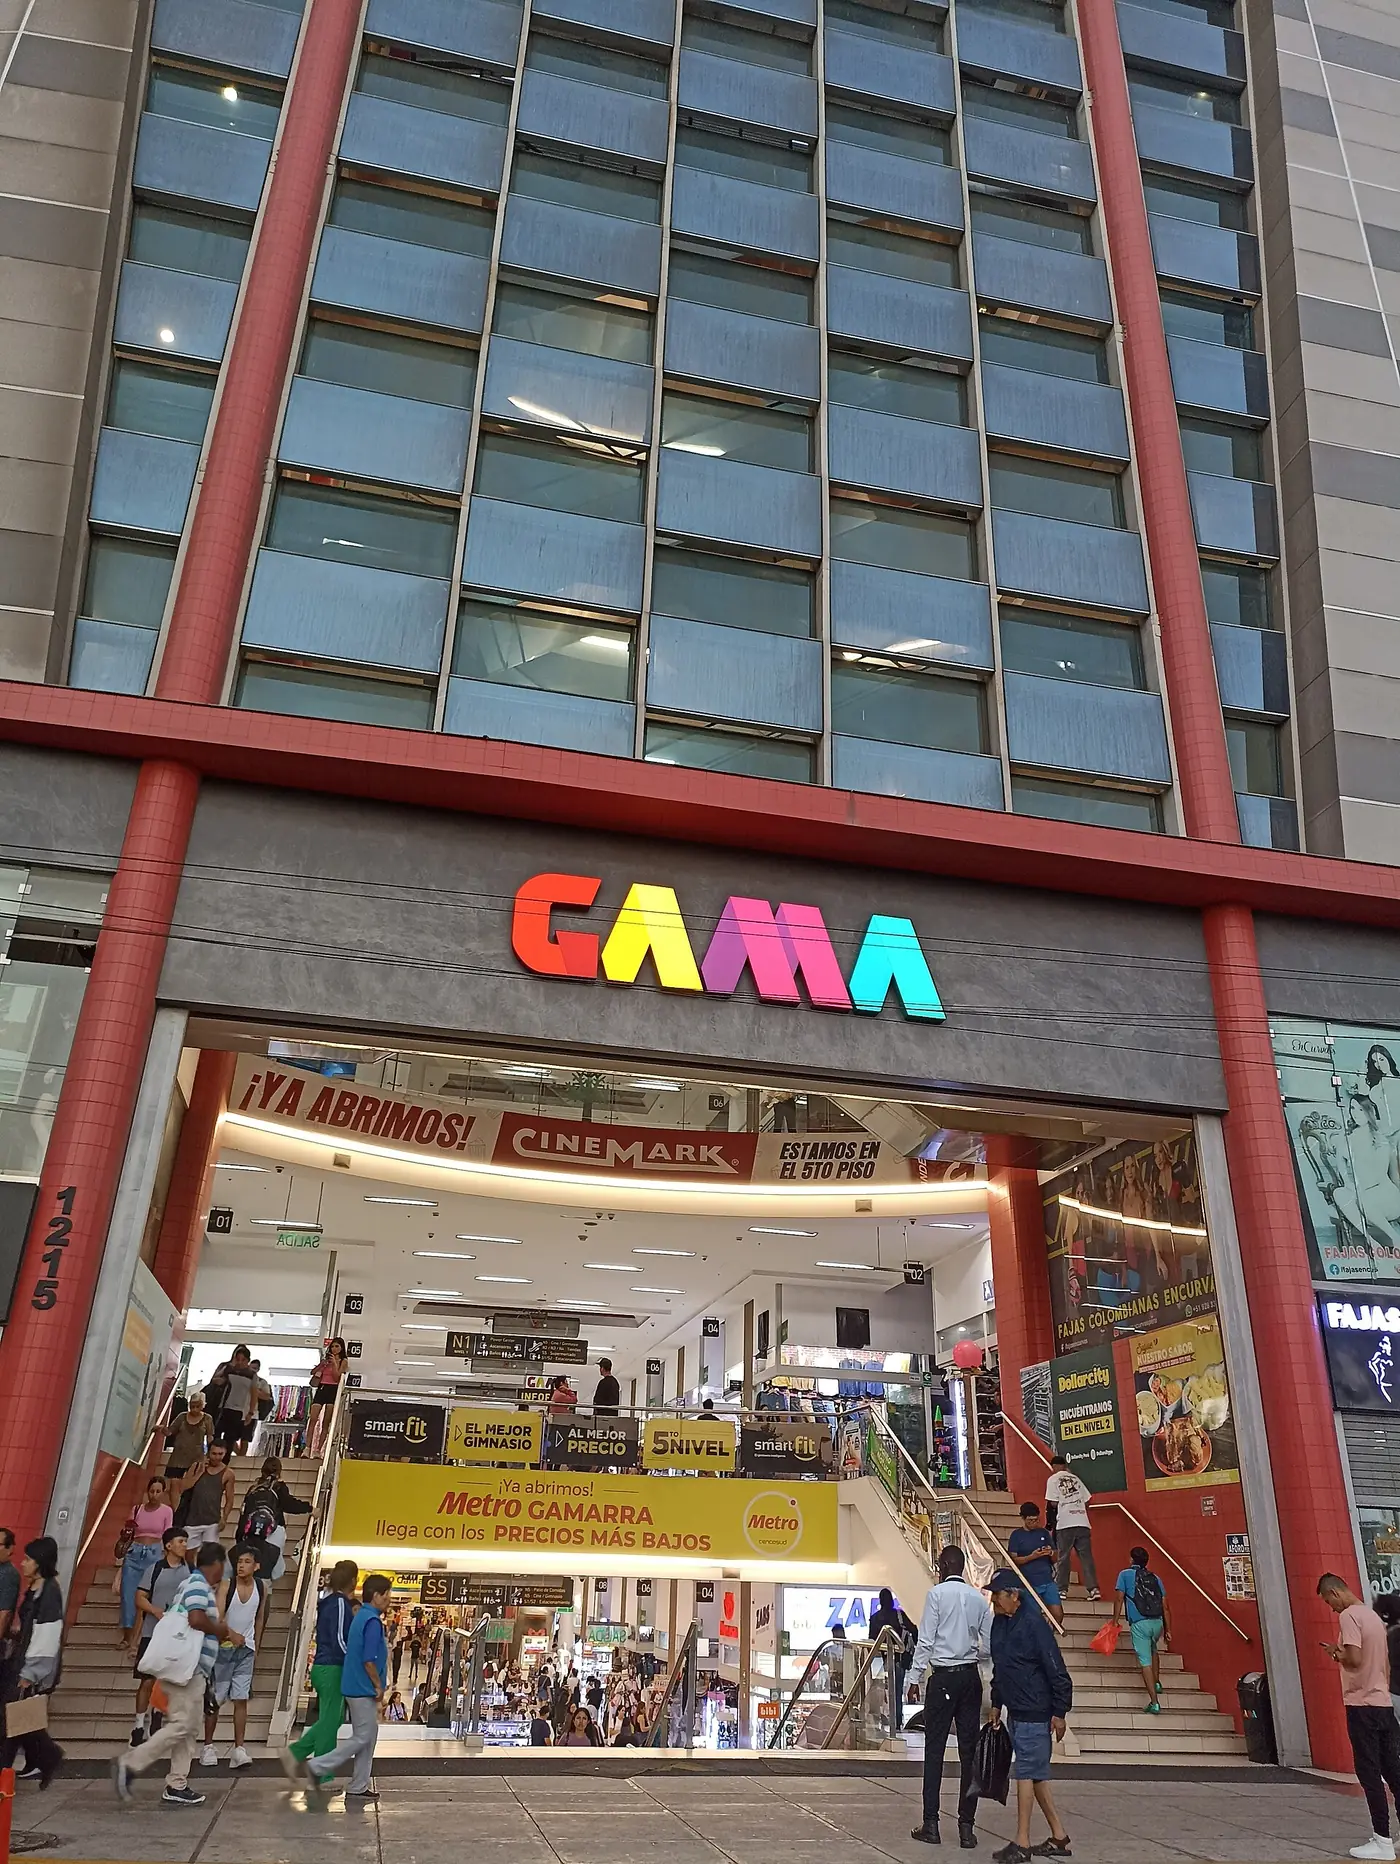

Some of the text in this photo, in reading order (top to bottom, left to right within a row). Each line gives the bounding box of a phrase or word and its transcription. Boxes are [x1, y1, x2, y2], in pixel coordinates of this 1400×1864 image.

[511, 873, 947, 1024] GAMA
[238, 1070, 476, 1151] ¡YA ABRIMOS!
[713, 1098, 724, 1108] 06
[779, 1141, 881, 1160] ESTAMOS EN
[779, 1161, 875, 1180] EL 5TO PISO
[216, 1215, 230, 1228] 01
[31, 1186, 77, 1311] 1215
[1324, 1246, 1365, 1260] FAJAS
[911, 1269, 923, 1281] 02
[350, 1300, 362, 1310] 03
[1058, 1318, 1086, 1339] FAJAS
[1089, 1292, 1160, 1330] COLOMBIANAS
[707, 1323, 719, 1334] 04
[452, 1334, 471, 1349] N1
[351, 1345, 361, 1355] 05
[1137, 1349, 1168, 1366] NUESTRO
[1168, 1341, 1195, 1358] SABOR
[650, 1363, 660, 1372] 06
[1058, 1366, 1110, 1392] Dollarcity
[1060, 1400, 1113, 1421] ENCUÉNTRANOS
[364, 1416, 428, 1437] smart fit
[465, 1423, 532, 1437] EL MEJOR
[568, 1428, 627, 1441] AL MEJOR
[1064, 1419, 1111, 1436] EN EL NIVEL 2
[464, 1436, 532, 1450] GIMNASIO
[567, 1440, 627, 1456] PRECIO
[670, 1438, 730, 1457] NIVEL
[754, 1435, 817, 1456] smart fit
[499, 1478, 594, 1498] ¡Ya abrimos!
[437, 1491, 654, 1526] Metro GAMARRA
[748, 1514, 799, 1531] Metro
[376, 1520, 711, 1552] llega con los PRECIOS MÁS BAJOS
[426, 1579, 447, 1595] SS
[599, 1581, 608, 1590] 08
[641, 1583, 651, 1593] 06
[702, 1587, 713, 1599] 04
